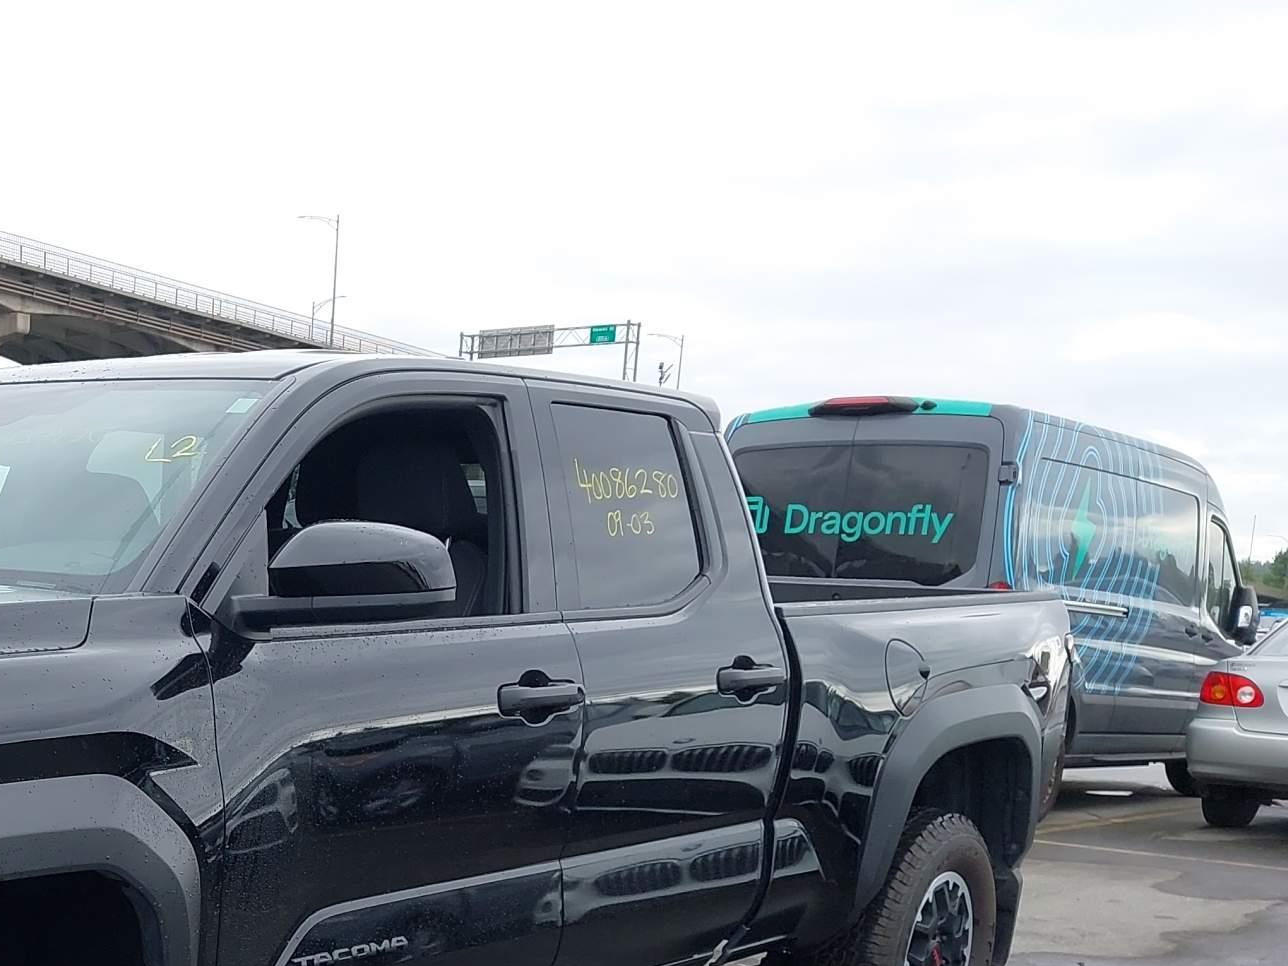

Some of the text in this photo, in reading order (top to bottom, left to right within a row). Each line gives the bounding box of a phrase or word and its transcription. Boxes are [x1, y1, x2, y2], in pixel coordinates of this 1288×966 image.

[574, 458, 678, 504] 40086280
[607, 510, 655, 537] 09-03
[784, 503, 954, 543] Dragonfly
